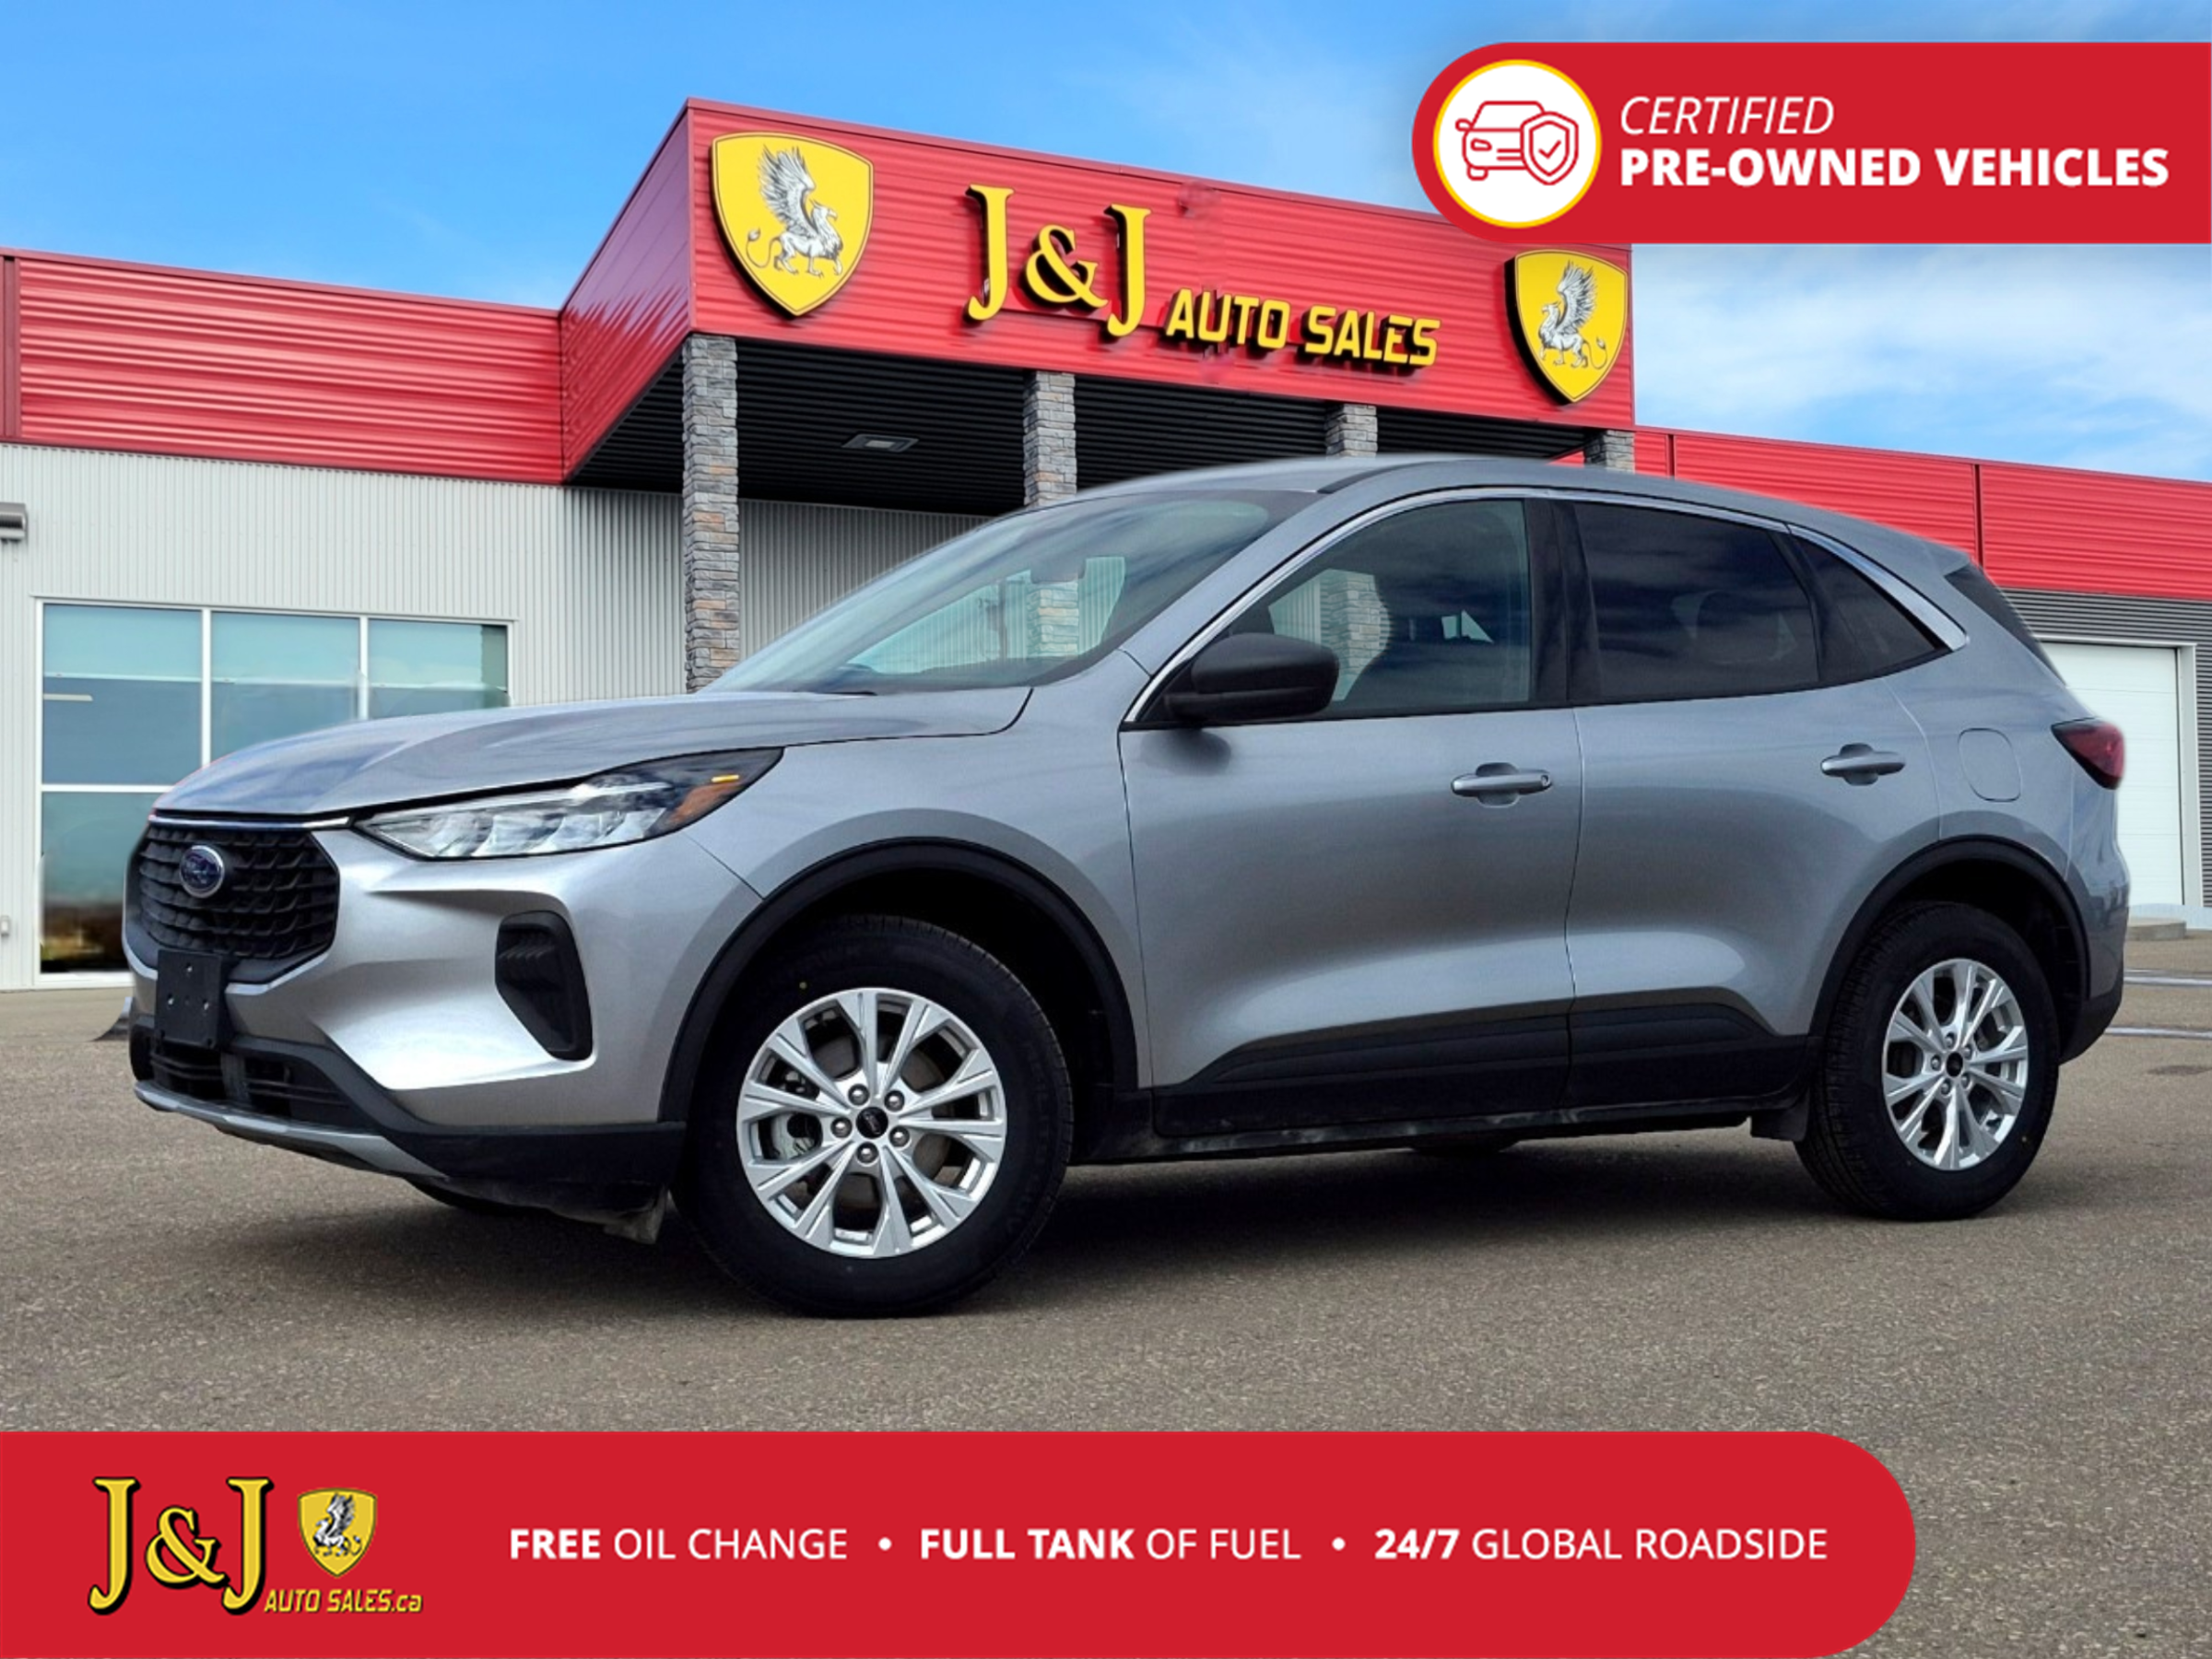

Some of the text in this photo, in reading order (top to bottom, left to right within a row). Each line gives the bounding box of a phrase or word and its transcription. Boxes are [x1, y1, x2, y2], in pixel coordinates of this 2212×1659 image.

[965, 183, 1441, 367] J&J AUTO SALES
